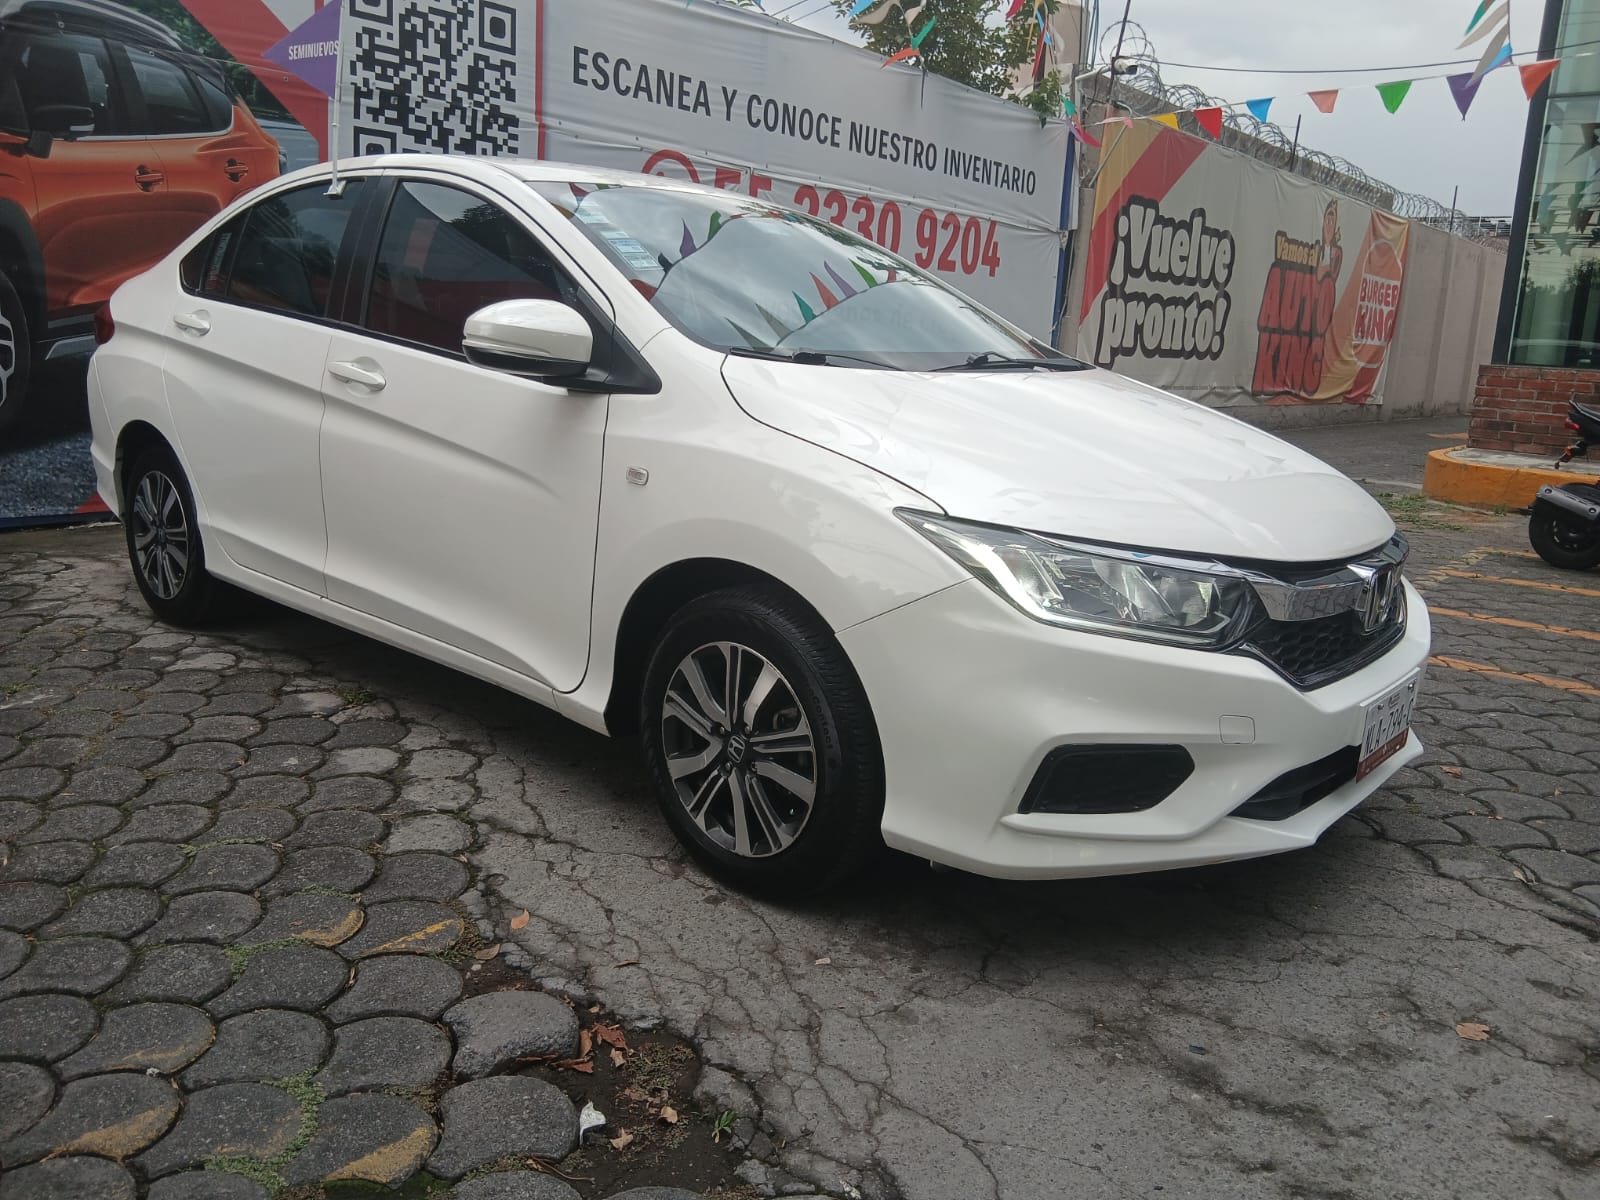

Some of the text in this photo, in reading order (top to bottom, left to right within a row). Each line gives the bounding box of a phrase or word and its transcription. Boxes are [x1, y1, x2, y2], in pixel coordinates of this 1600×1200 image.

[288, 40, 339, 60] SEMINUEVOS
[573, 45, 1036, 196] ESCANEA Y CONOCE NUESTRO INVENTARIO
[915, 208, 1001, 278] 9204
[1109, 204, 1233, 286] ¡Vuelve
[1276, 234, 1320, 267] Vamos al
[1259, 266, 1336, 333] AUTO
[1355, 304, 1396, 342] KING
[1360, 277, 1400, 307] BURGER
[1100, 296, 1228, 364] pronto!
[1253, 333, 1326, 395] KING
